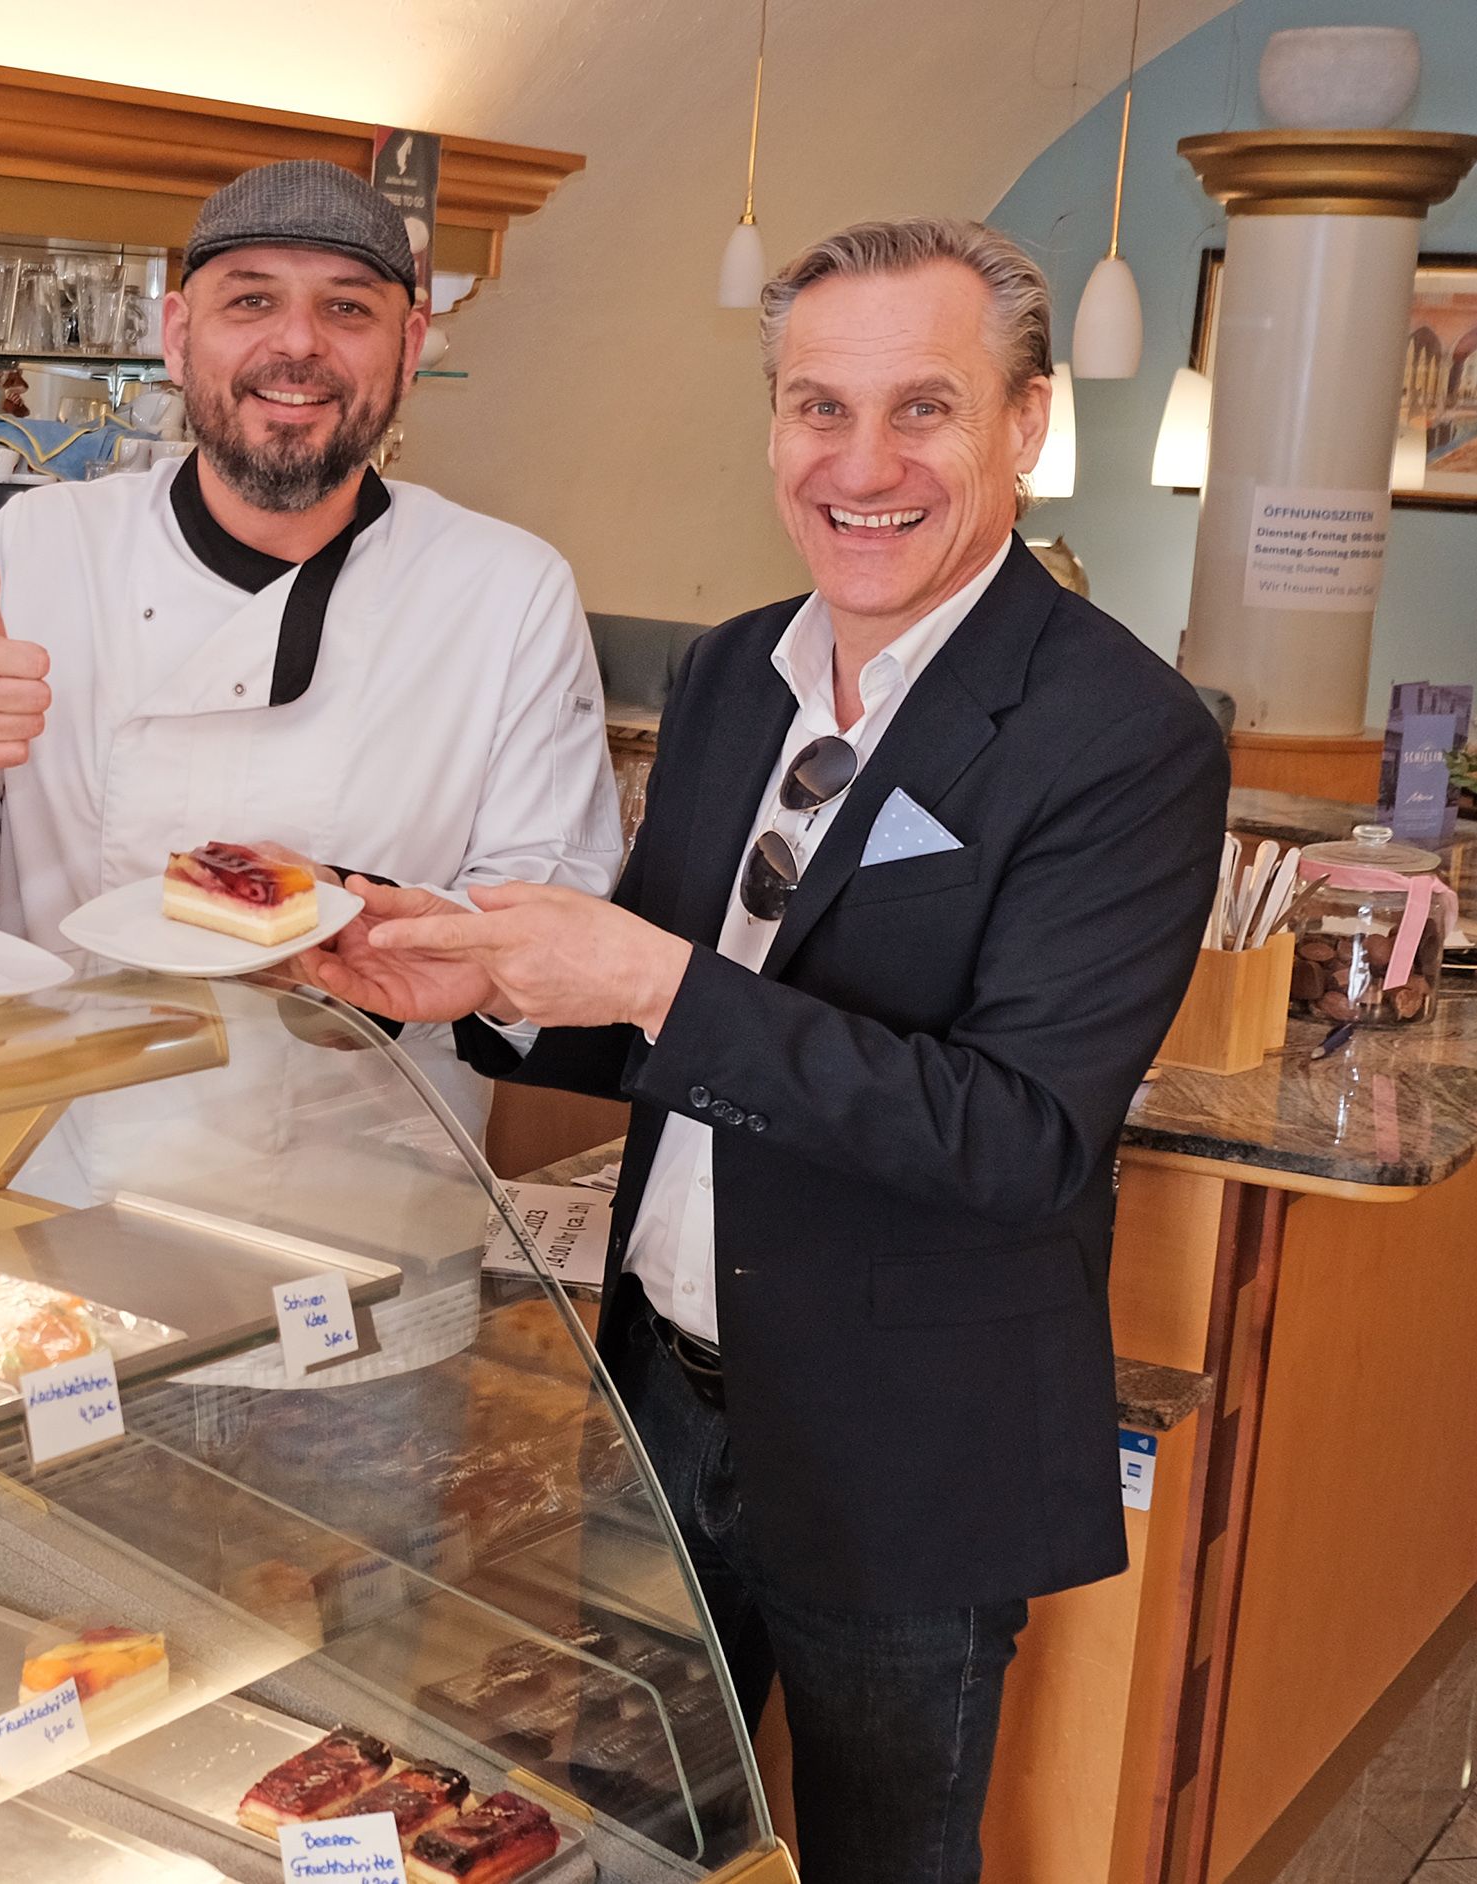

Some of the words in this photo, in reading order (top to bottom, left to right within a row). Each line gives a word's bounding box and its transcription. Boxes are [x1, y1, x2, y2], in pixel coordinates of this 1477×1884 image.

[1264, 504, 1374, 521] ÖFFNUNGSZEITEN
[1257, 527, 1348, 543] Dienstag-Freitag
[290, 1853, 396, 1877] Fruchtschnitte
